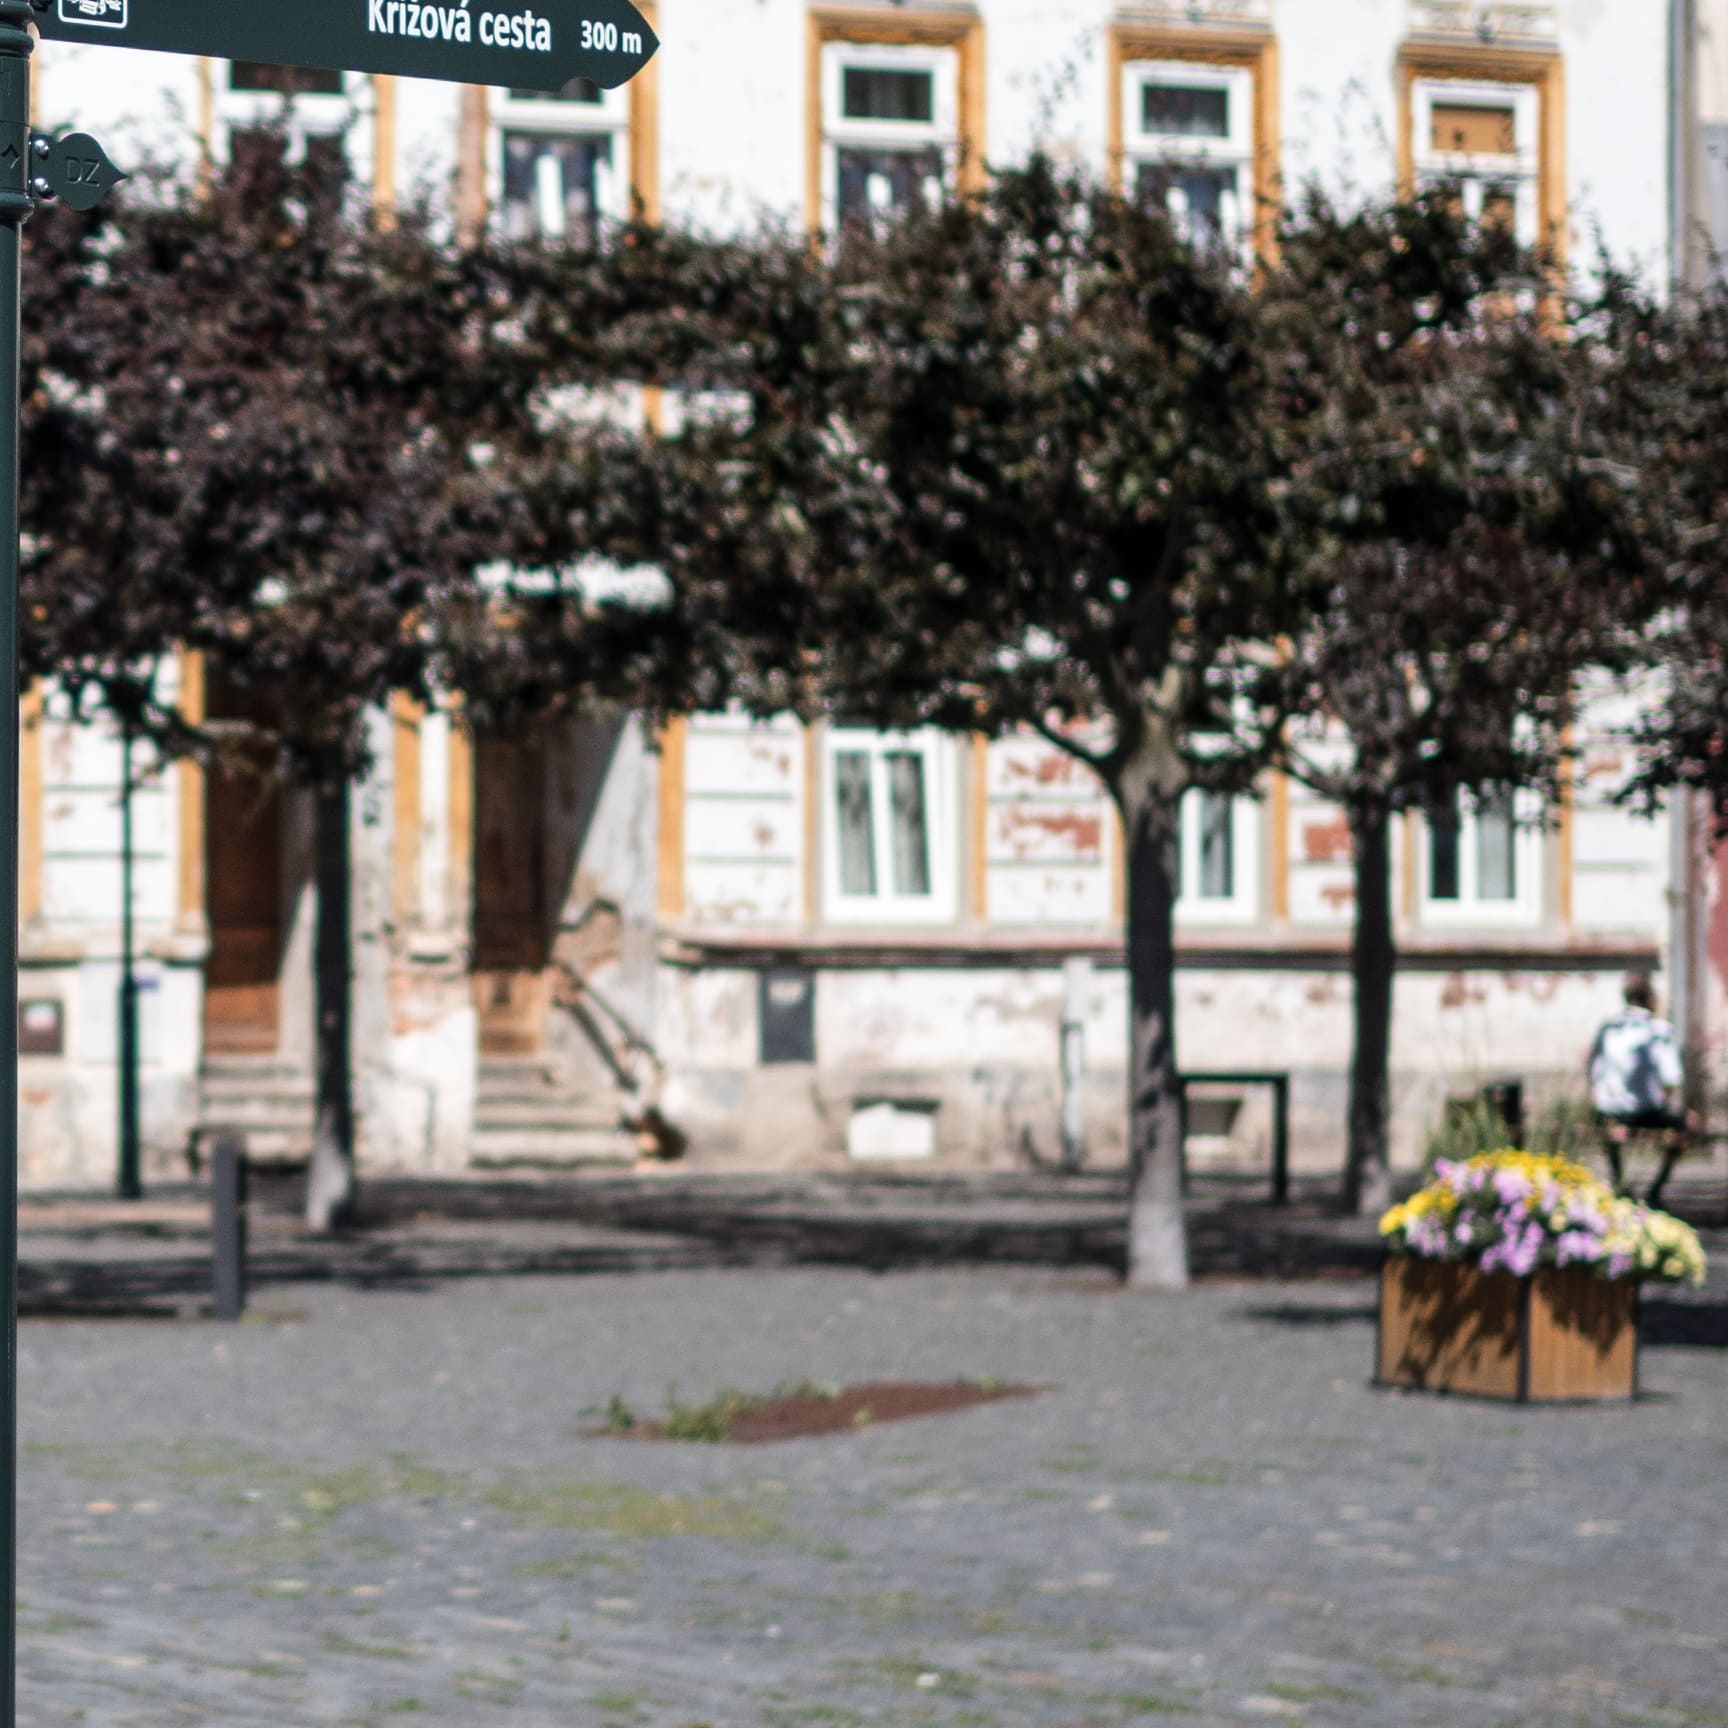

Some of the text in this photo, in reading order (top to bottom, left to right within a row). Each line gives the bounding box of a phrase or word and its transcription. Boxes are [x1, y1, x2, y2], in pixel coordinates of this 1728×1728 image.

[479, 9, 551, 52] cesta
[580, 19, 618, 52] 300
[622, 31, 642, 54] m
